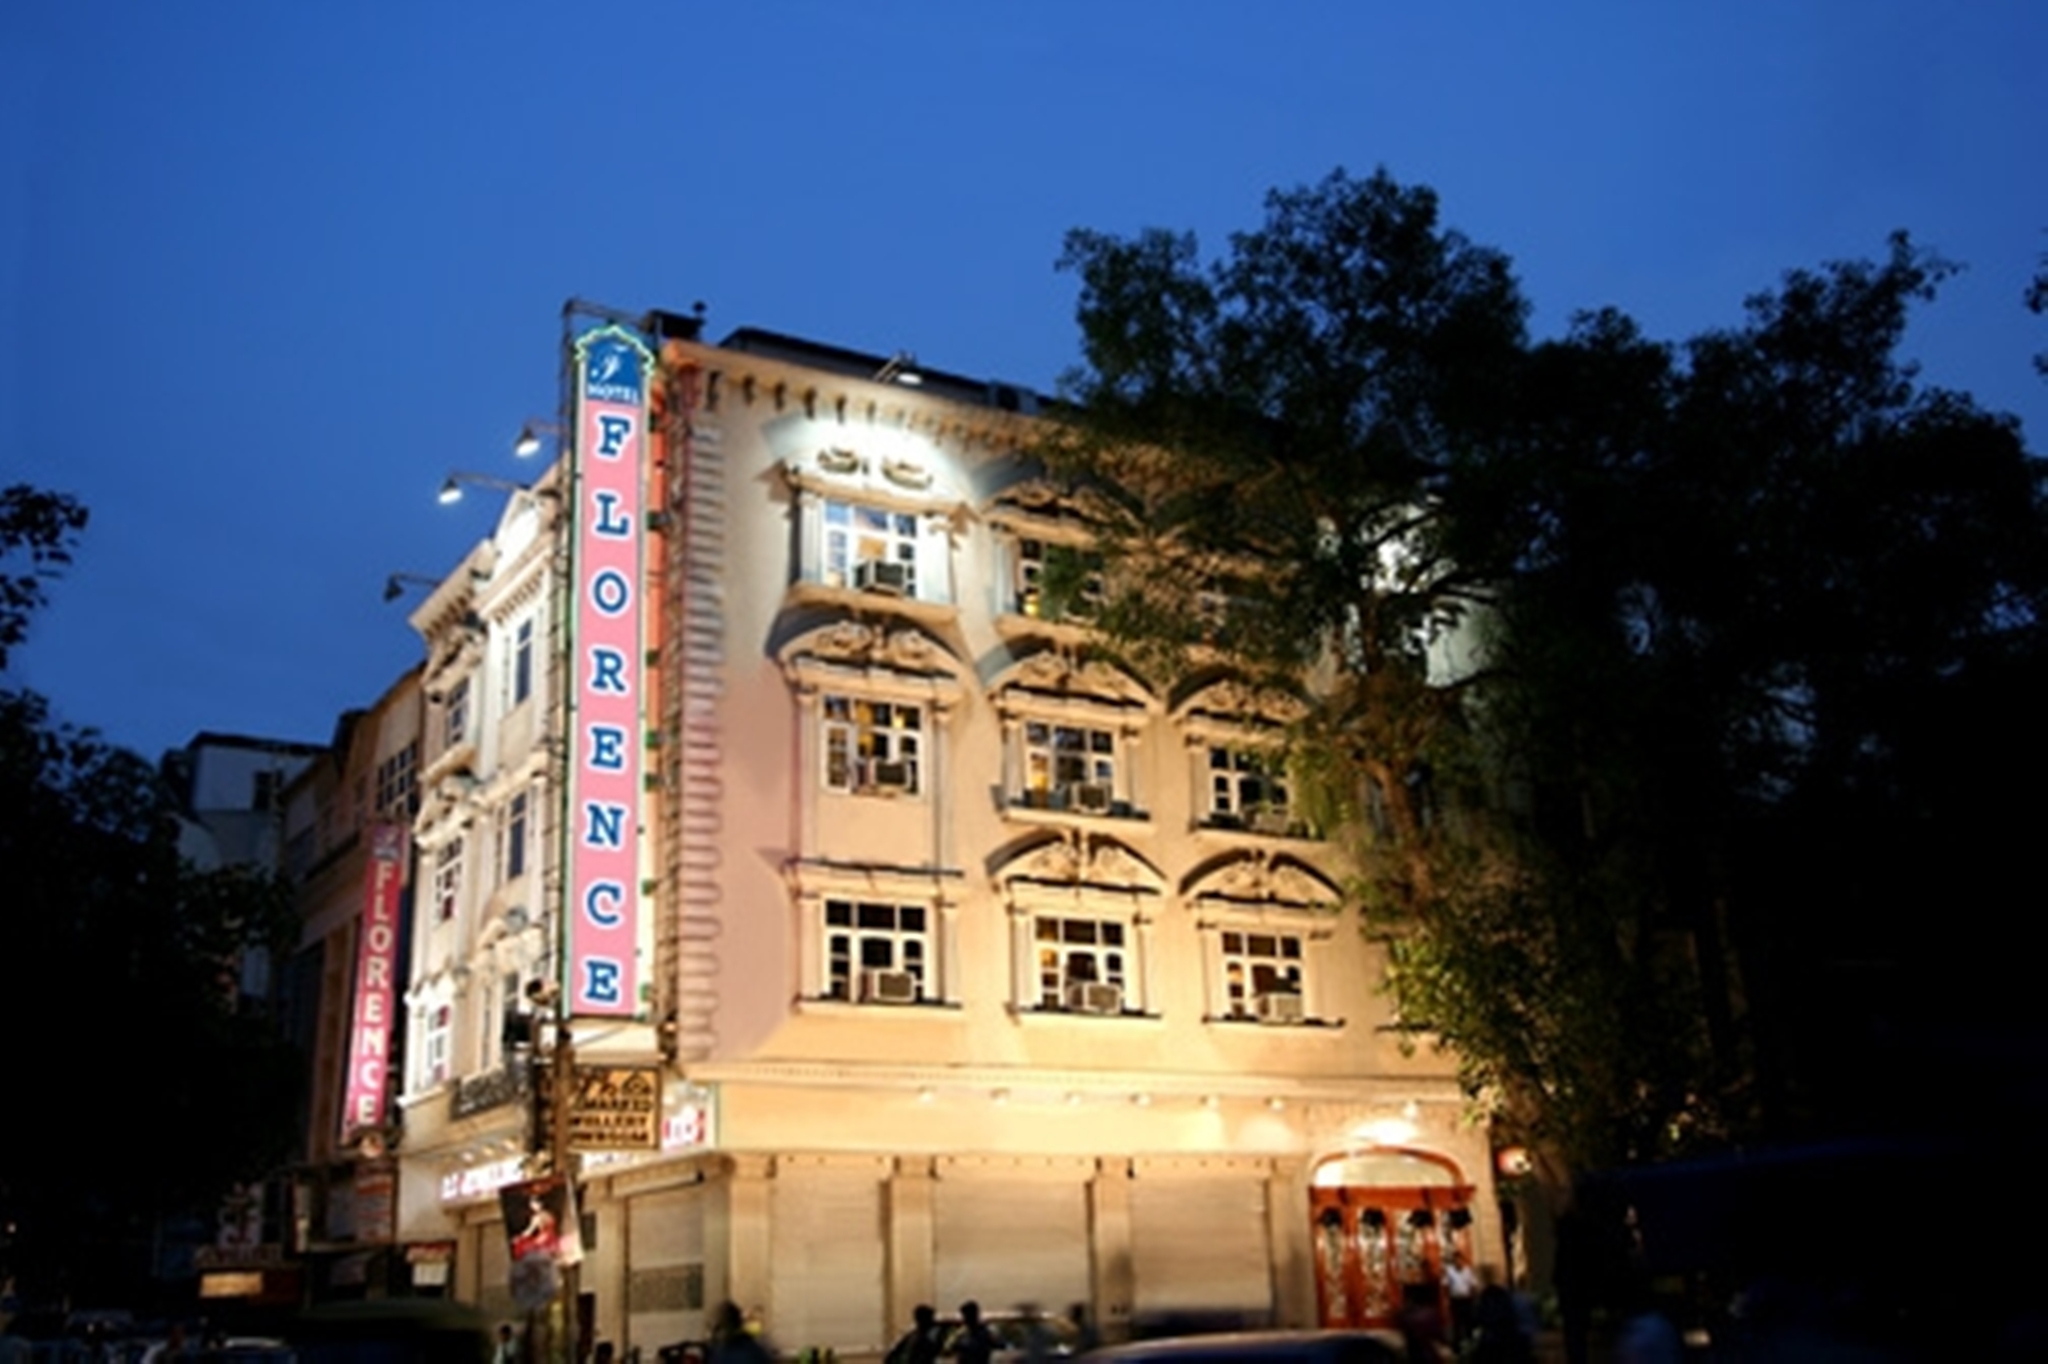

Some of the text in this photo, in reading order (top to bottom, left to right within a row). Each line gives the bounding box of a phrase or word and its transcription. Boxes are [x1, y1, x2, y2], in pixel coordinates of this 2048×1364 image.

[587, 384, 638, 406] HOTEL
[584, 414, 631, 1003] FLORENCE
[356, 859, 393, 1126] FLORENCE
